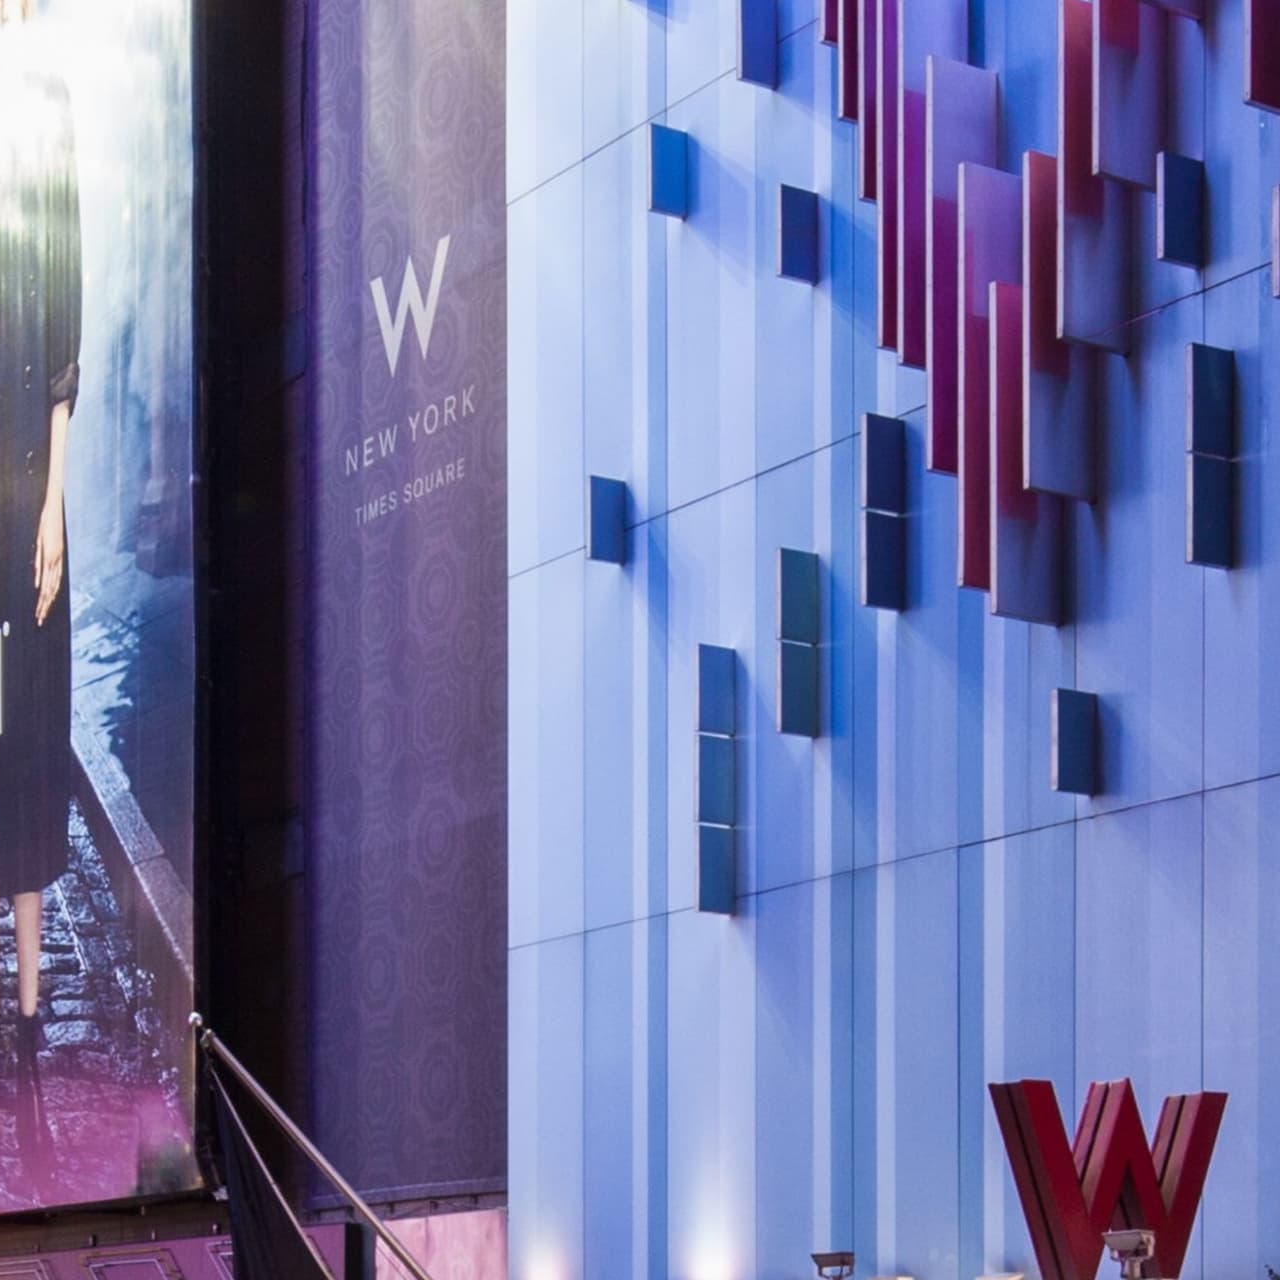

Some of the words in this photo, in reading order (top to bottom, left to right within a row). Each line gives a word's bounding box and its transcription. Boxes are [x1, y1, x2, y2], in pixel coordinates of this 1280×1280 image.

[369, 233, 451, 378] W
[345, 424, 397, 476] NEW
[408, 384, 476, 442] YORK
[355, 490, 397, 527] TIMES
[403, 457, 466, 504] SQUARE
